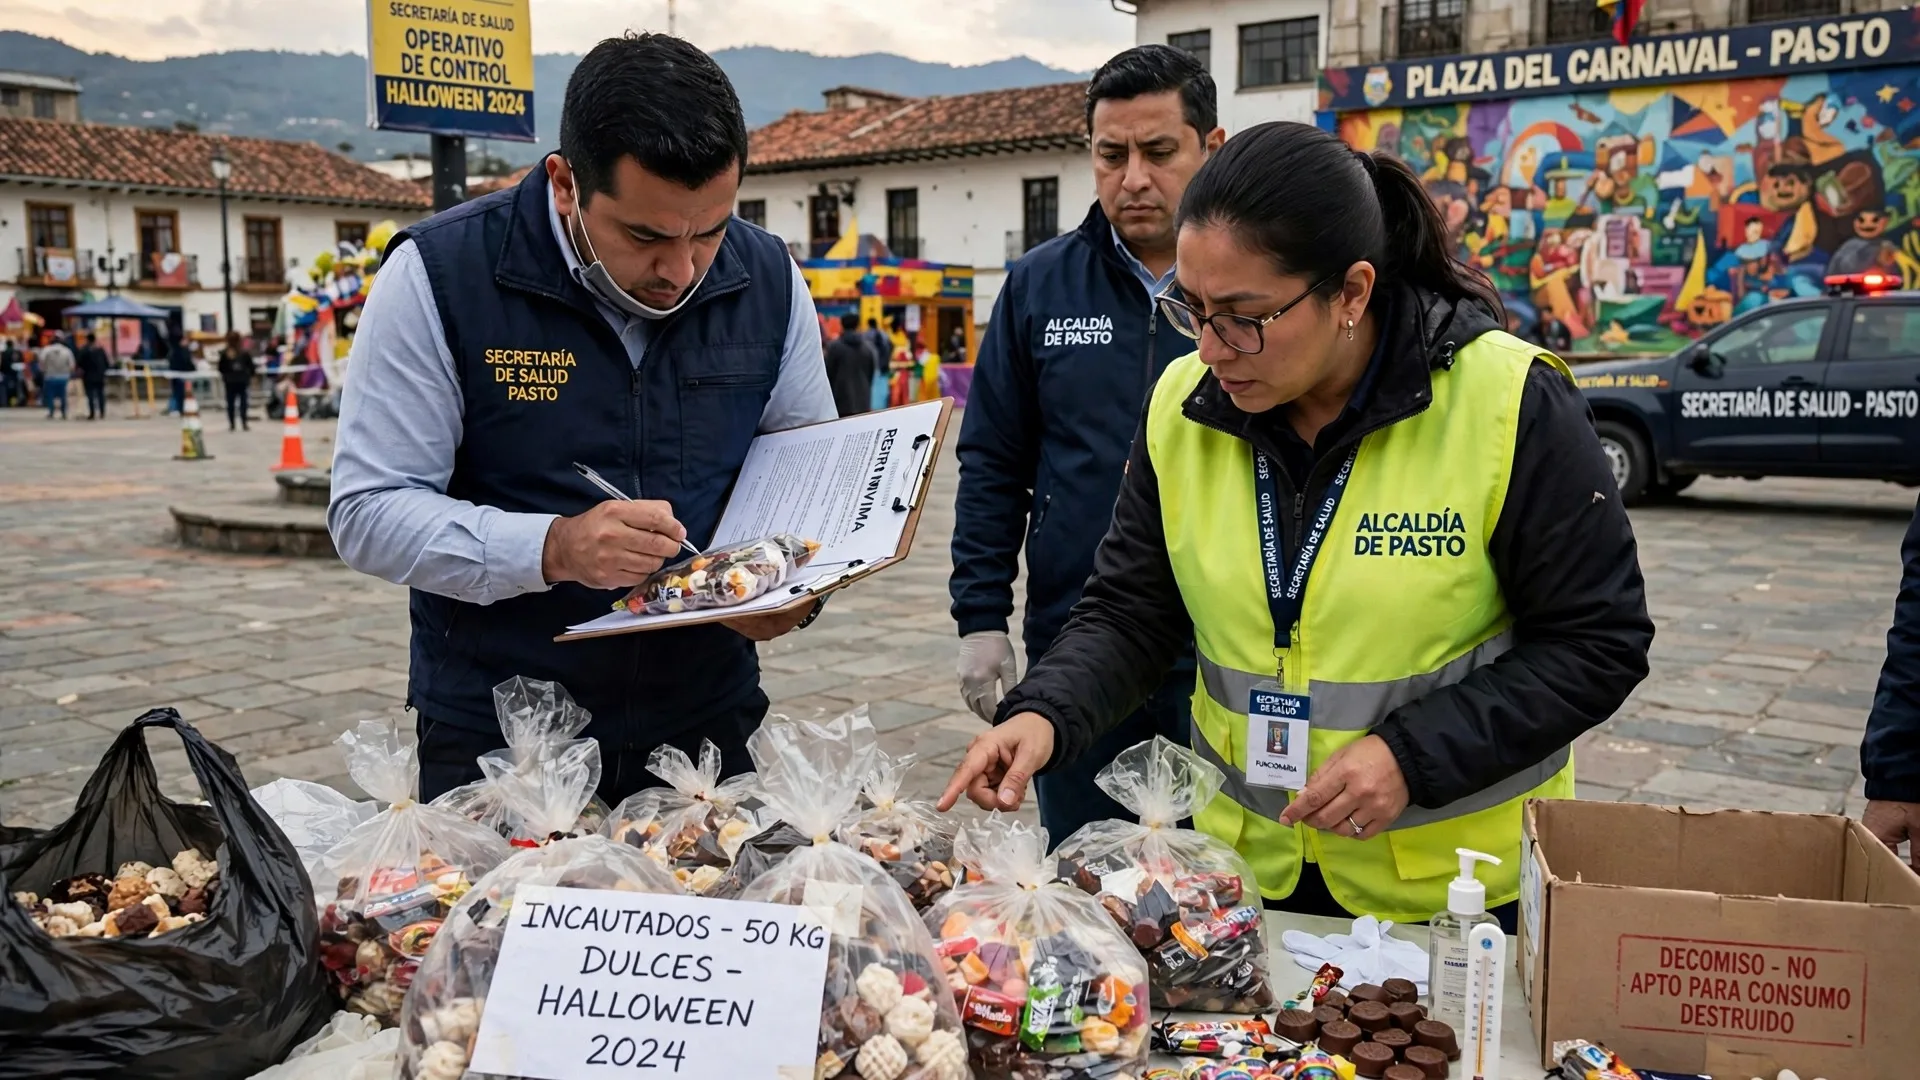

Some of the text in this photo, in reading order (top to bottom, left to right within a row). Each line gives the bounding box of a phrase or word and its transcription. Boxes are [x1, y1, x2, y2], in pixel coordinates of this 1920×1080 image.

[389, 2, 515, 32] SECRETARÍA DE SALUD
[405, 28, 504, 60] OPERATIVO
[1406, 17, 1891, 99] PLAZA DEL CARNAVAL - PASTO
[401, 53, 512, 85] DE CONTROL
[386, 80, 526, 116] HALLOWEEN 2024
[1044, 331, 1113, 347] DE PASTO
[1045, 314, 1114, 332] ALCALDÍA
[485, 349, 577, 367] SECRETARÍA
[495, 368, 569, 385] DE SALUD
[508, 386, 559, 401] PASTO
[1681, 386, 1771, 418] SECRETARÍA
[1774, 390, 1795, 418] DE
[1798, 390, 1851, 418] SALUD
[1865, 390, 1919, 418] PASTO
[1356, 507, 1466, 533] ALCALDÍA
[1261, 492, 1282, 599] SECRETARÍA DE SALUD
[1287, 497, 1336, 600] SECRETARÍA DE SALUD
[1354, 535, 1466, 557] DE PASTO
[1260, 704, 1270, 713] DE
[521, 902, 712, 940] INCAUTADOS
[743, 918, 780, 945] 50
[789, 923, 826, 950] KG
[580, 945, 713, 982] DULCES
[1660, 946, 1765, 976] DECOMISO
[1787, 956, 1817, 980] NO
[537, 984, 755, 1028] HALLOWEEN
[1630, 972, 1851, 1010] APTO PARA CONSUMO
[1680, 1003, 1795, 1034] DESTRUIDO
[585, 1034, 687, 1073] 2024
